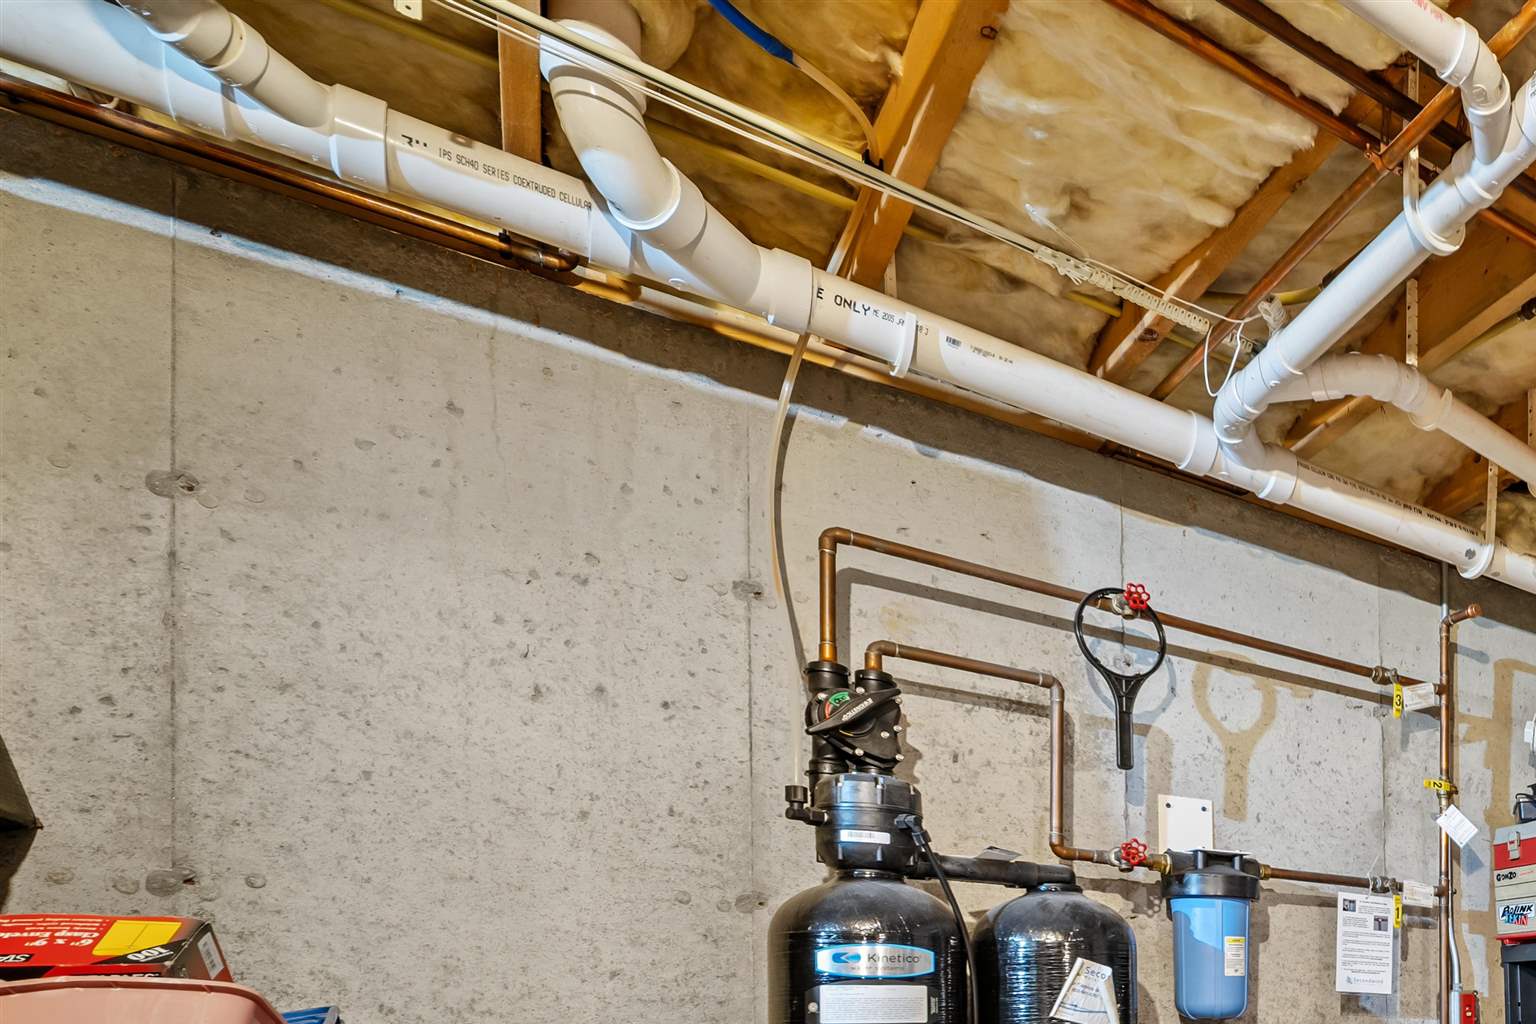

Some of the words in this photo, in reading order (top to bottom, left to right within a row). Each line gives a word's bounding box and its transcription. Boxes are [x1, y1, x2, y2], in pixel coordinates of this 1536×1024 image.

[455, 154, 479, 171] SCH40
[482, 163, 510, 182] SERIES
[512, 174, 556, 199] COEXTRUDED
[559, 191, 592, 211] CELLULAR
[834, 294, 871, 316] ONLY
[54, 930, 100, 938] Clasp
[127, 946, 173, 962] 100
[867, 952, 920, 963] Kinetico
[1085, 966, 1106, 980] Seco
